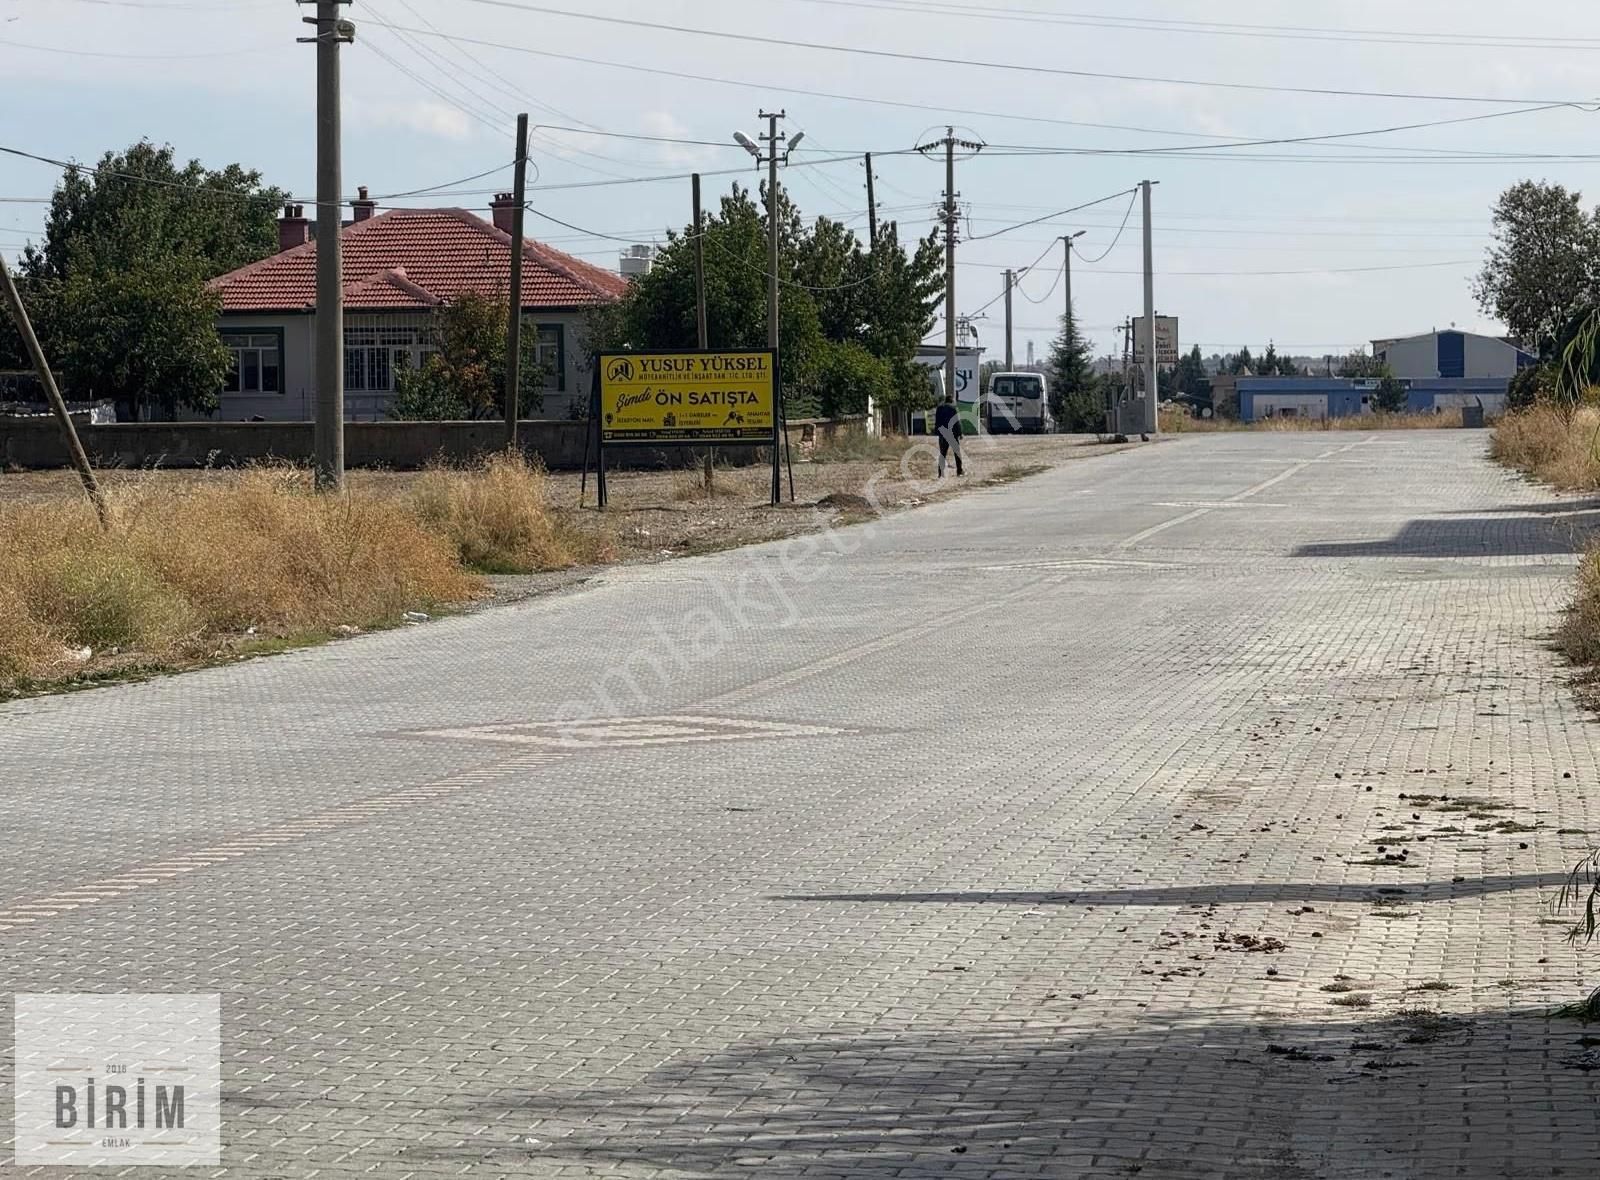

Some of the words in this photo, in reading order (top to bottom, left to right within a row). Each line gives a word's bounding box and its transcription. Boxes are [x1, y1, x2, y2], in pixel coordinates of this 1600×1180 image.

[639, 358, 696, 372] YUSUF
[700, 356, 767, 371] YÜKSEL
[655, 389, 682, 406] ÖN
[688, 391, 759, 408] SATIŞTA
